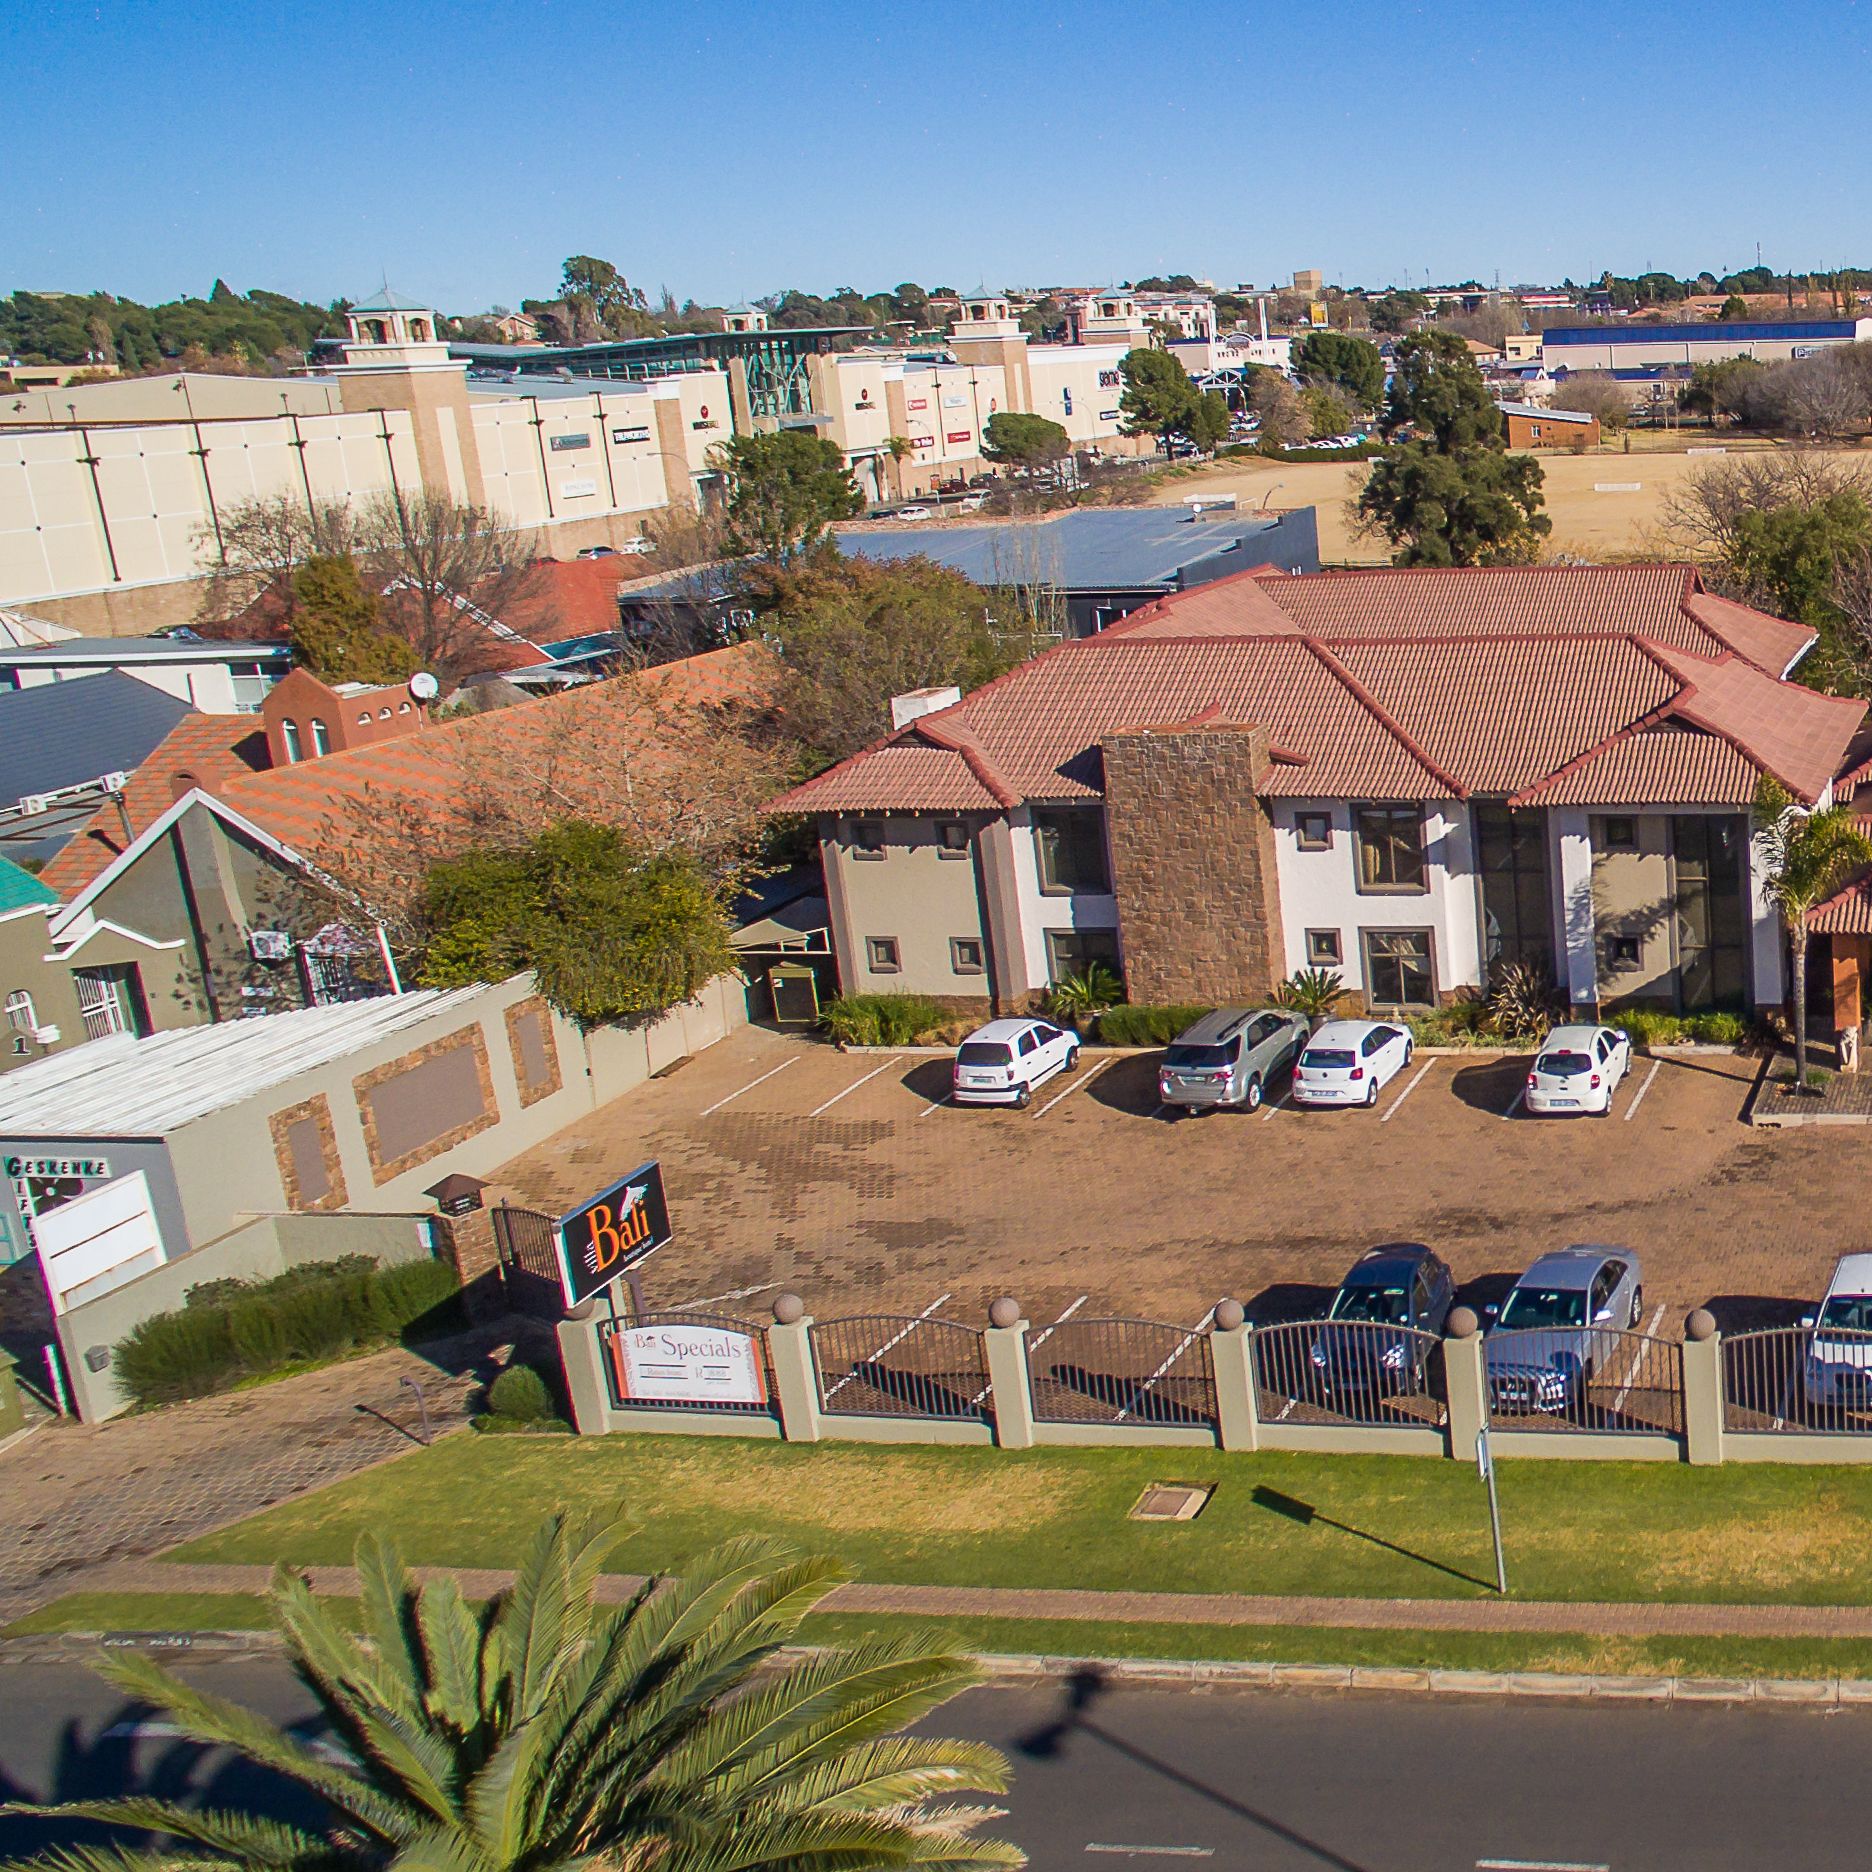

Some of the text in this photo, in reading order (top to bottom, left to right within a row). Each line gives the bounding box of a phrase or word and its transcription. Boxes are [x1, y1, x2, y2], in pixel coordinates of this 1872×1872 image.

[11, 1036, 31, 1055] 1
[7, 1156, 105, 1176] GESKENKE
[586, 1199, 651, 1272] Bali
[661, 1333, 742, 1360] Specials
